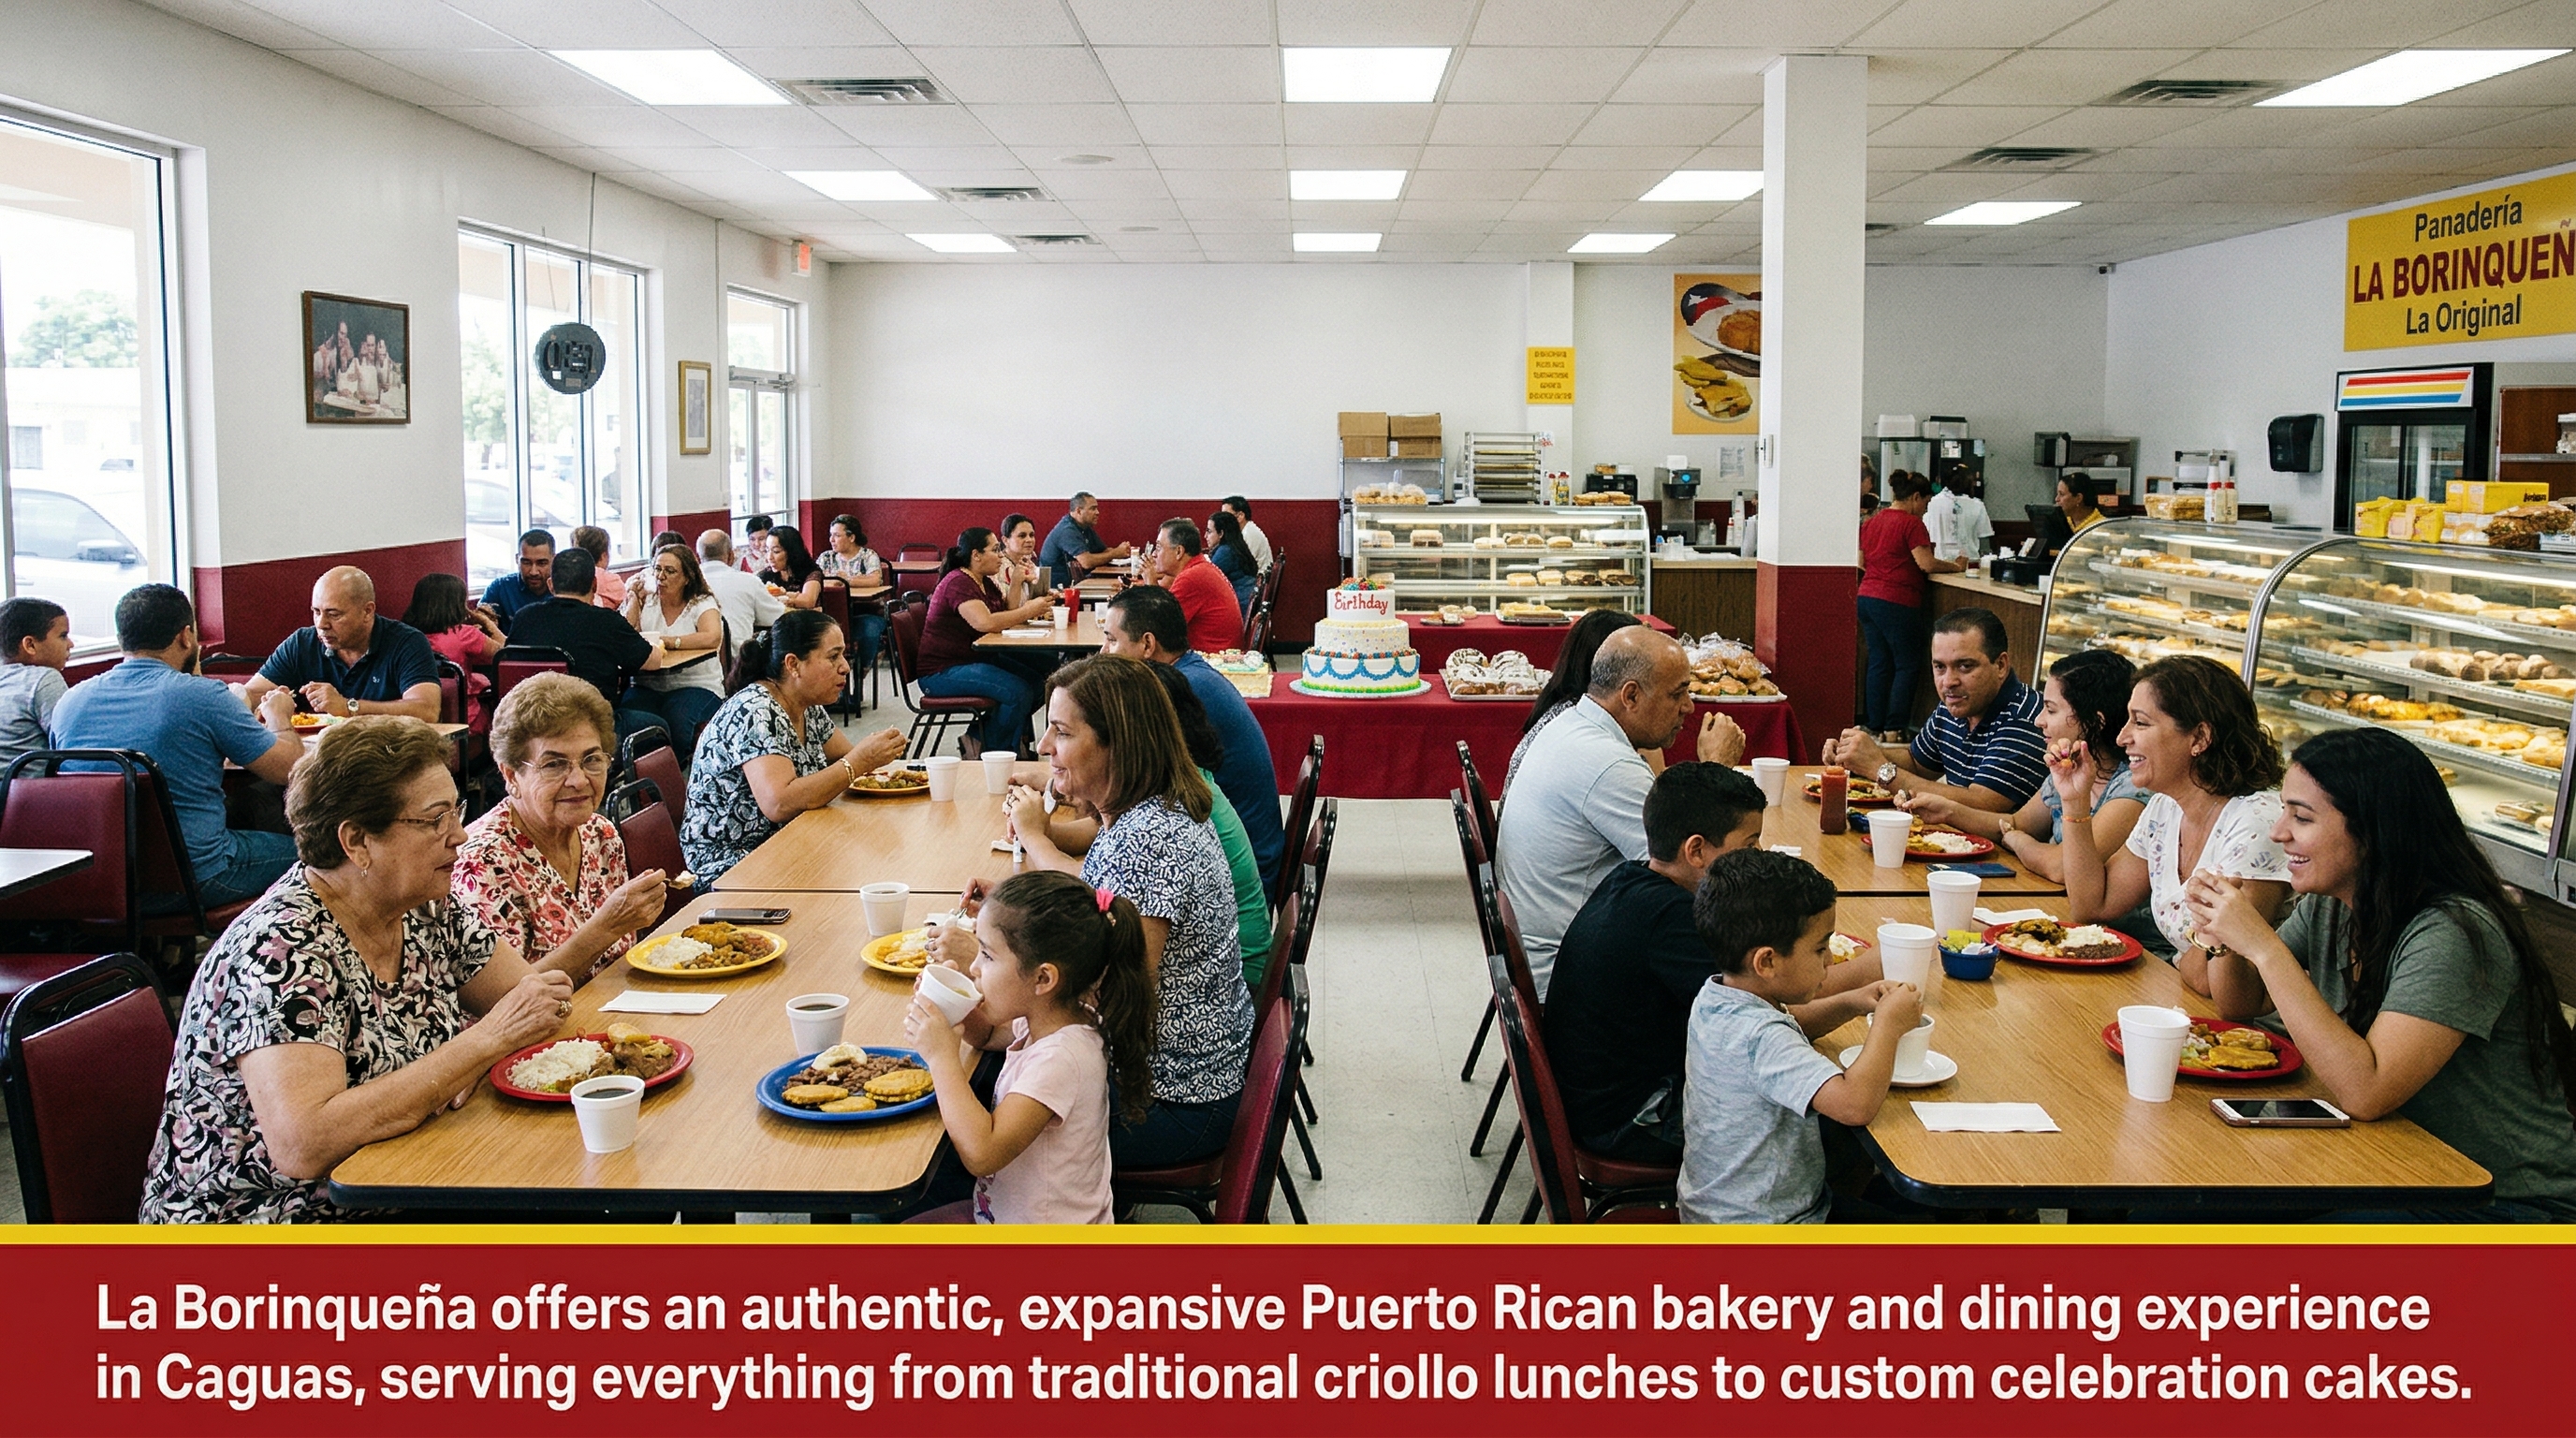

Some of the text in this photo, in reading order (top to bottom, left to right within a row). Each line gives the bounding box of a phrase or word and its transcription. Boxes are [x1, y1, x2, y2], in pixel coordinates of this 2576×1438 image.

[2414, 194, 2524, 242] Panadería
[2353, 262, 2385, 303] LA
[2406, 293, 2523, 337] La Original
